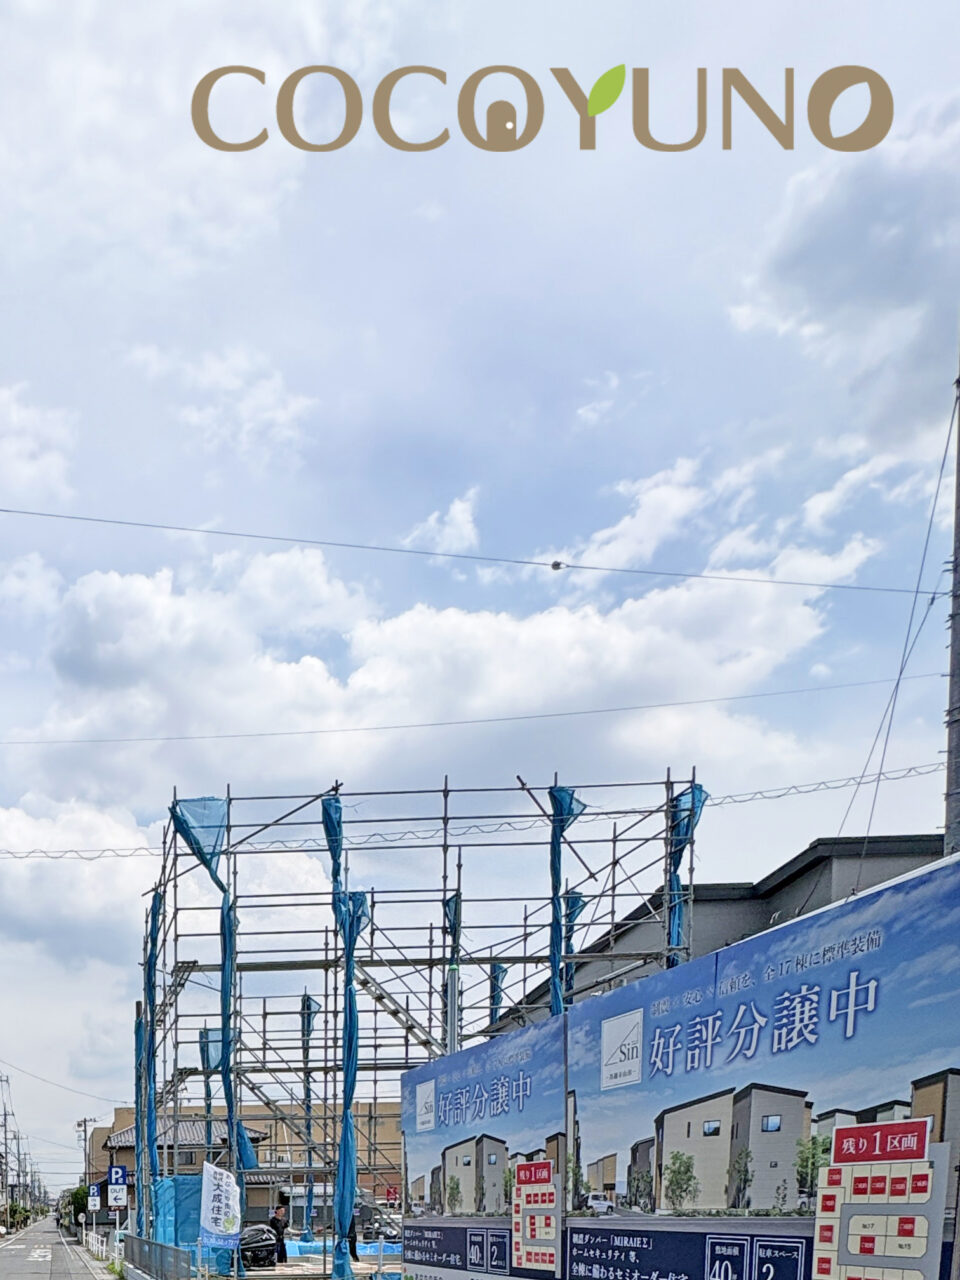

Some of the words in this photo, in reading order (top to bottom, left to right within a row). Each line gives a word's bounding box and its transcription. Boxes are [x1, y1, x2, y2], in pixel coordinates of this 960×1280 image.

[649, 971, 878, 1078] 好評分譲中
[619, 1043, 639, 1062] Sin
[438, 1071, 531, 1126] 好評分譲中
[842, 1131, 918, 1154] 残り1区画
[211, 1183, 224, 1227] 大成住宅
[491, 1246, 498, 1265] 2
